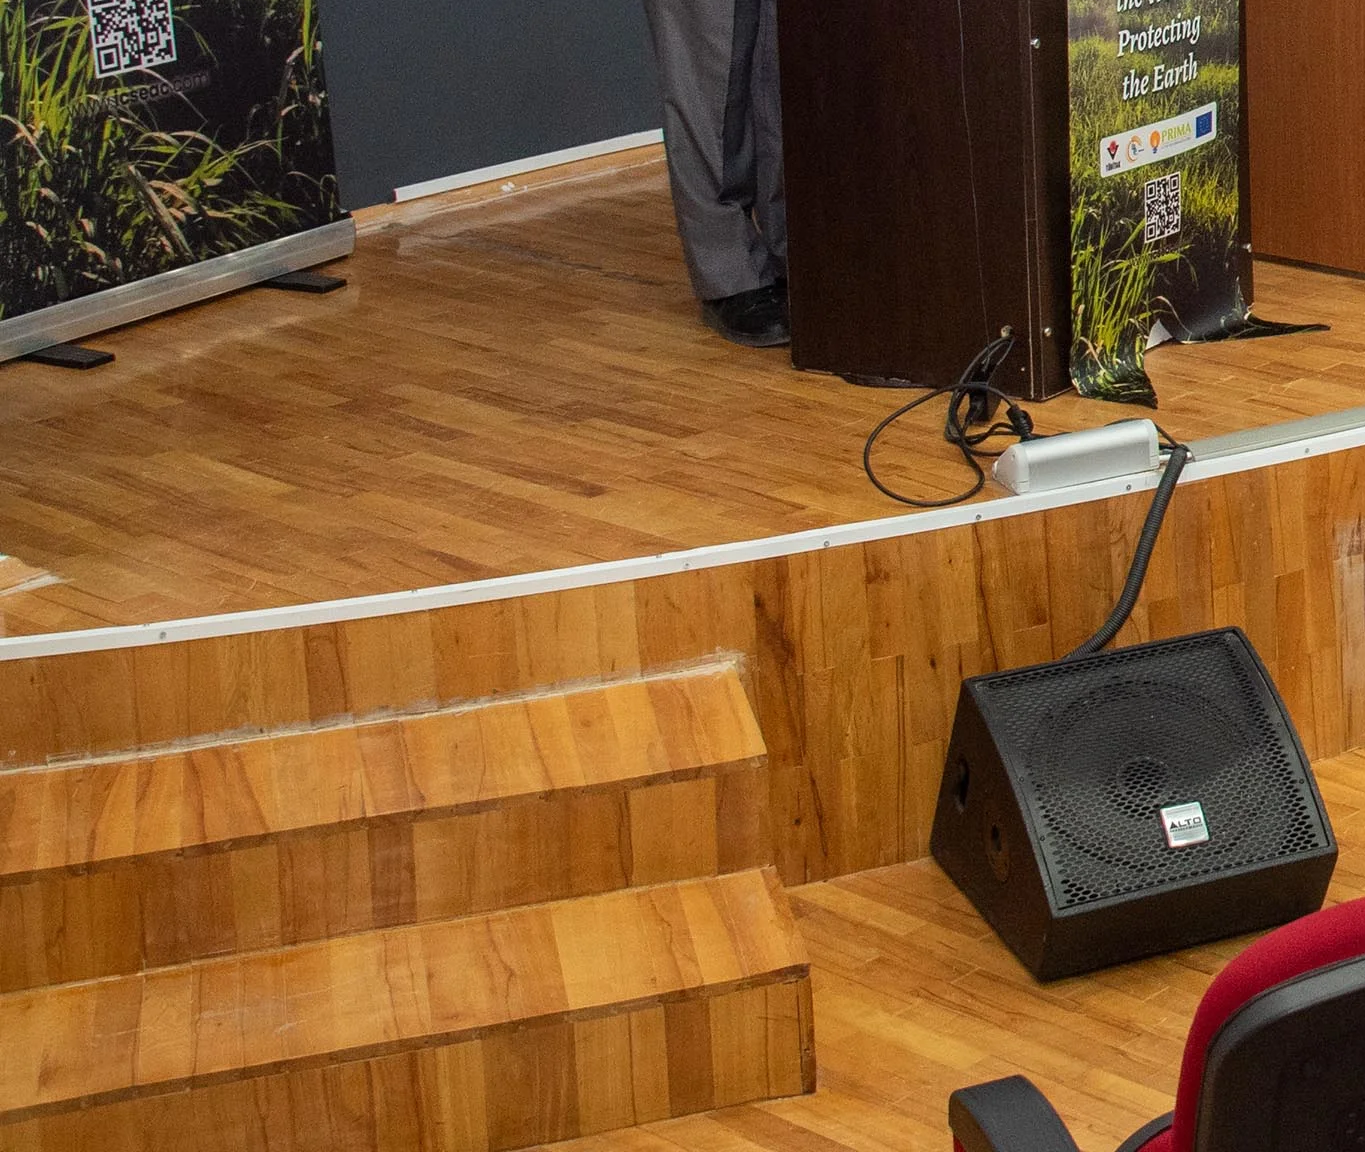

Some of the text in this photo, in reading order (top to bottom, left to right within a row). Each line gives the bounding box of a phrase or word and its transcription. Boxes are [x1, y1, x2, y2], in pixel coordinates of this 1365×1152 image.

[1117, 14, 1201, 58] Protecting
[1122, 52, 1198, 101] the Earth
[1162, 123, 1192, 142] PRIMA
[1170, 816, 1202, 830] ALTO
